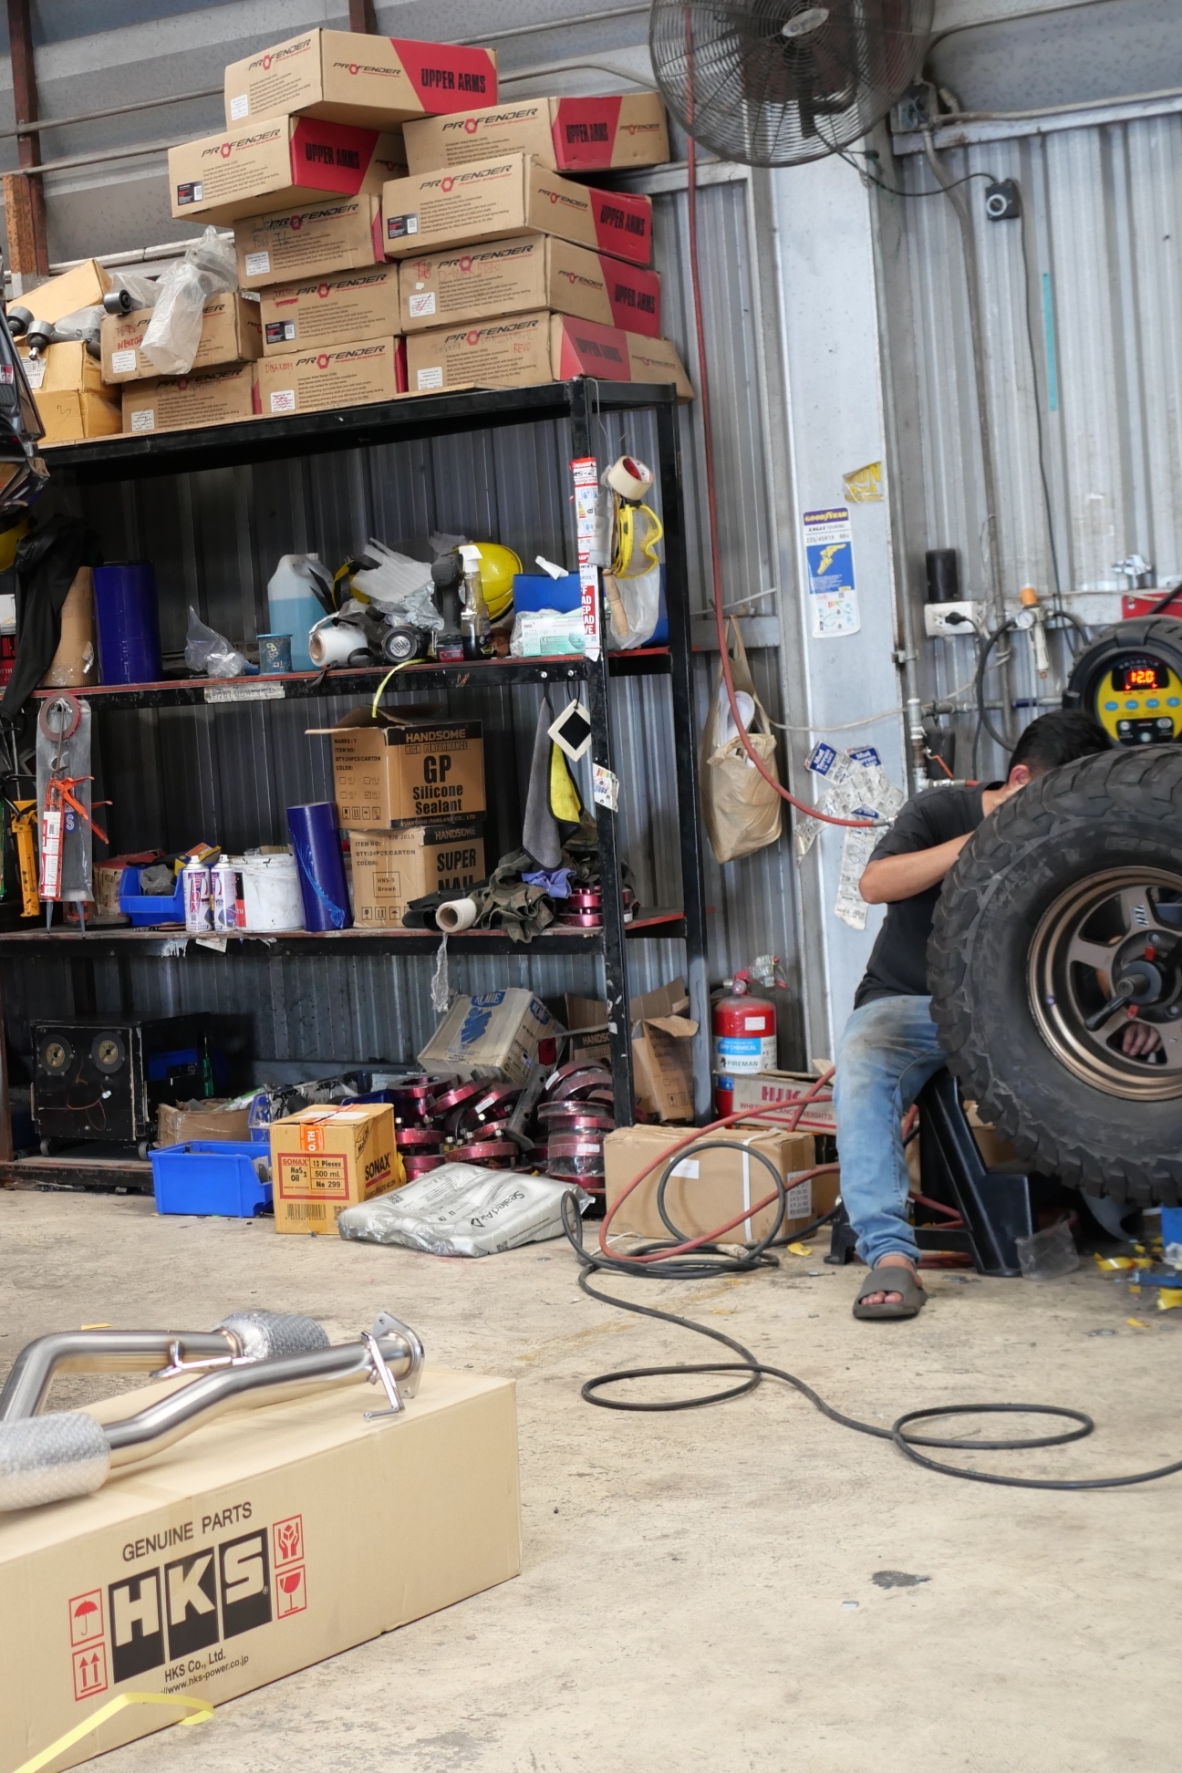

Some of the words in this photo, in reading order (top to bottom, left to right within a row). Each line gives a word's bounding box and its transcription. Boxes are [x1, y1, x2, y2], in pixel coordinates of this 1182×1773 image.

[248, 39, 311, 71] PROFENDER
[333, 62, 401, 75] PROFENDER
[421, 68, 455, 90] UPPER
[458, 73, 486, 93] ARMS
[442, 108, 538, 134] PROFENDER
[201, 129, 280, 158] PROFENDER
[305, 143, 334, 165] UPPER
[336, 148, 360, 170] ARMS
[419, 165, 512, 192] PROFENDER
[538, 188, 588, 208] PROFENDER
[269, 203, 358, 231] PROFENDER
[600, 205, 624, 229] UPPER
[625, 213, 646, 237] ARMS
[438, 245, 533, 271] PROFENDER
[296, 274, 387, 298] PROFENDER
[615, 284, 636, 307] UPPER
[637, 292, 655, 314] ARMS
[445, 320, 538, 346] PROFENDER
[296, 345, 385, 369] PROFENDER
[157, 368, 243, 391] PROFENDER
[805, 511, 848, 522] GOODYEAR
[405, 729, 466, 743] HANDSOME
[423, 741, 468, 754] PERFORMANCE
[423, 754, 452, 784] GP
[412, 784, 463, 800] Silicone
[415, 799, 462, 815] Sealant
[435, 826, 476, 840] HANDSOME
[437, 848, 476, 872] SUPER
[282, 1158, 307, 1166] SONAX
[314, 1170, 328, 1178] 500
[365, 1155, 390, 1181] SONAX
[290, 1174, 300, 1182] Oil
[327, 1180, 341, 1188] 299
[491, 1191, 525, 1214] Sealed
[122, 1521, 193, 1562] GENUINE
[202, 1502, 253, 1534] PARTS
[111, 1534, 265, 1648] HKS
[164, 1664, 185, 1683] HKS
[187, 1660, 207, 1674] Co.,
[208, 1648, 226, 1665] Ltd.
